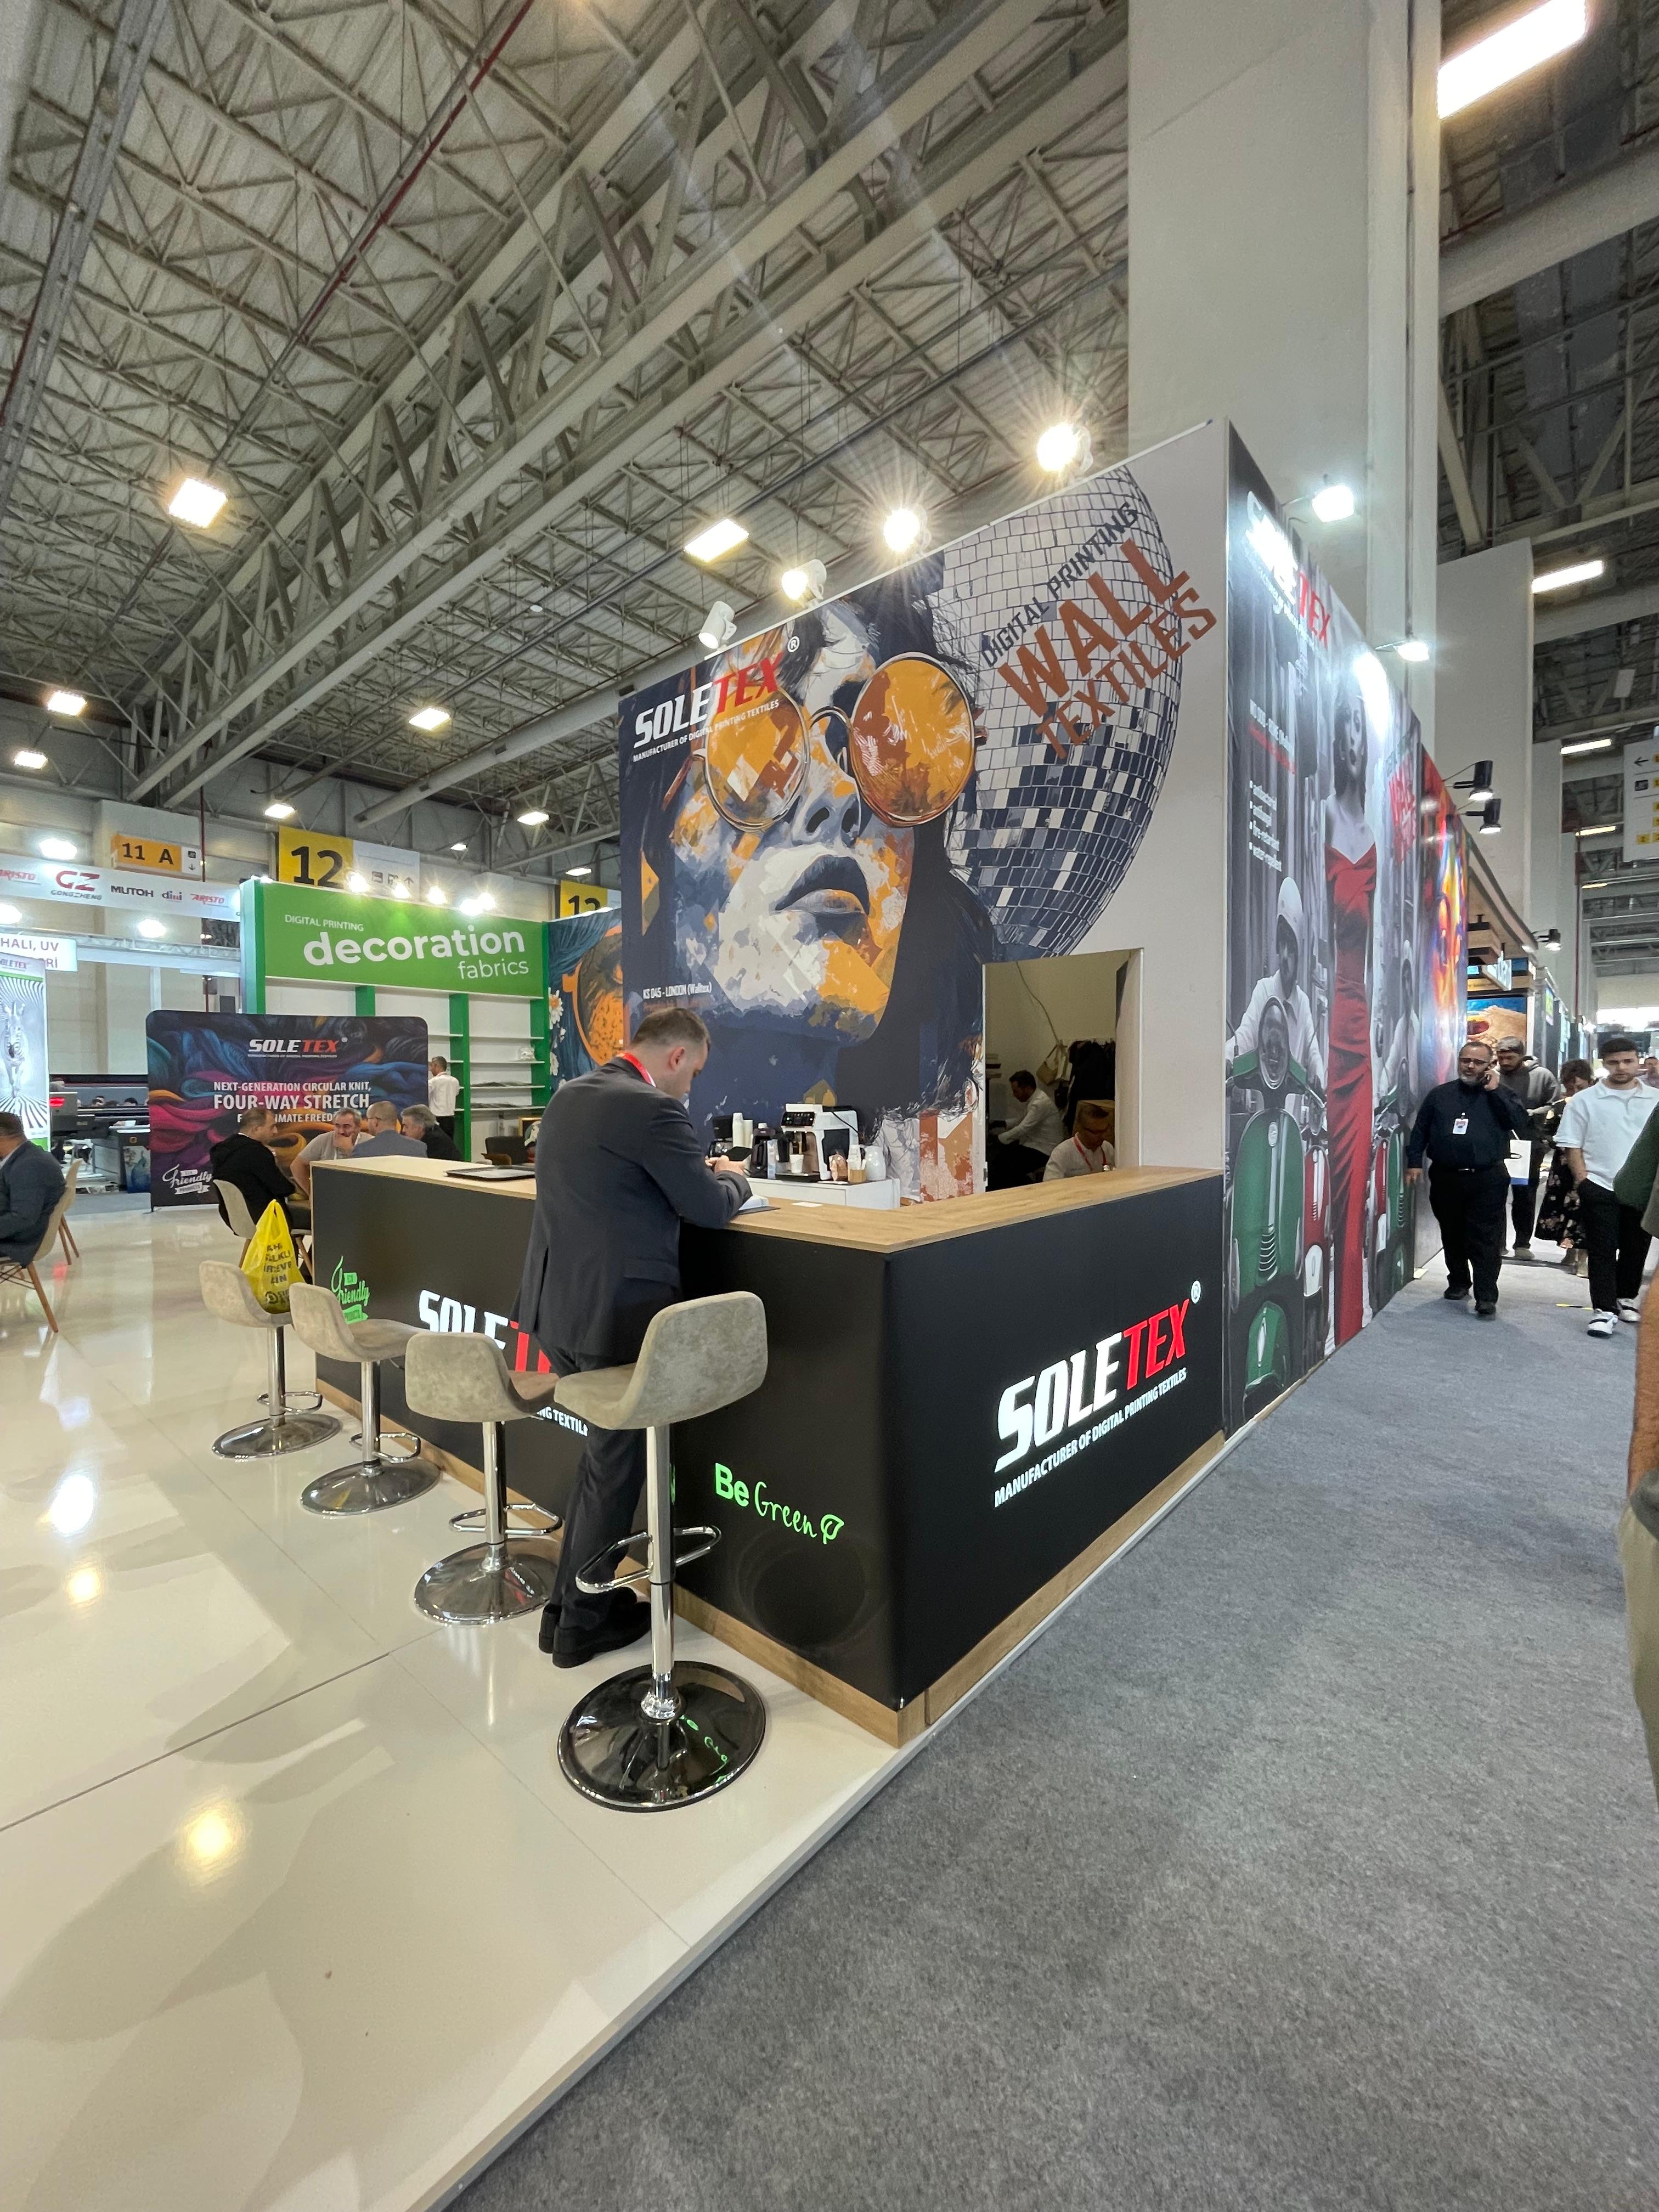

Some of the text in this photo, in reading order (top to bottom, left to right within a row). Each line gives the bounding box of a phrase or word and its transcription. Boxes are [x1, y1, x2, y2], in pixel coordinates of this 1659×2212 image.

[980, 501, 1138, 668] DIGITAL PRINTING
[997, 538, 1189, 718] WALL
[1035, 587, 1217, 759] TEXTILES
[633, 699, 779, 762] MANUFACTURER OF DIGITAL PRINTING TEXTILES
[122, 843, 173, 865] 11 A
[291, 846, 345, 890] 12
[56, 870, 100, 891] GZ
[111, 885, 154, 898] MUTOH
[50, 889, 102, 900] GONGZHENG
[190, 893, 224, 904] ARISTO
[285, 914, 364, 932] DIGITAL PRINTING
[41, 941, 59, 952] UV
[303, 924, 525, 966] decoration
[458, 958, 529, 980] fabrics
[214, 1081, 372, 1092] NEXT-GENERATION CIRCULAR KNIT,
[214, 1093, 370, 1110] FOUR-WAY STRETCH
[994, 1367, 1187, 1508] MANUFACTURER OF DIGITAL PRINTING TEXTILES
[715, 1463, 817, 1538] Be Green
